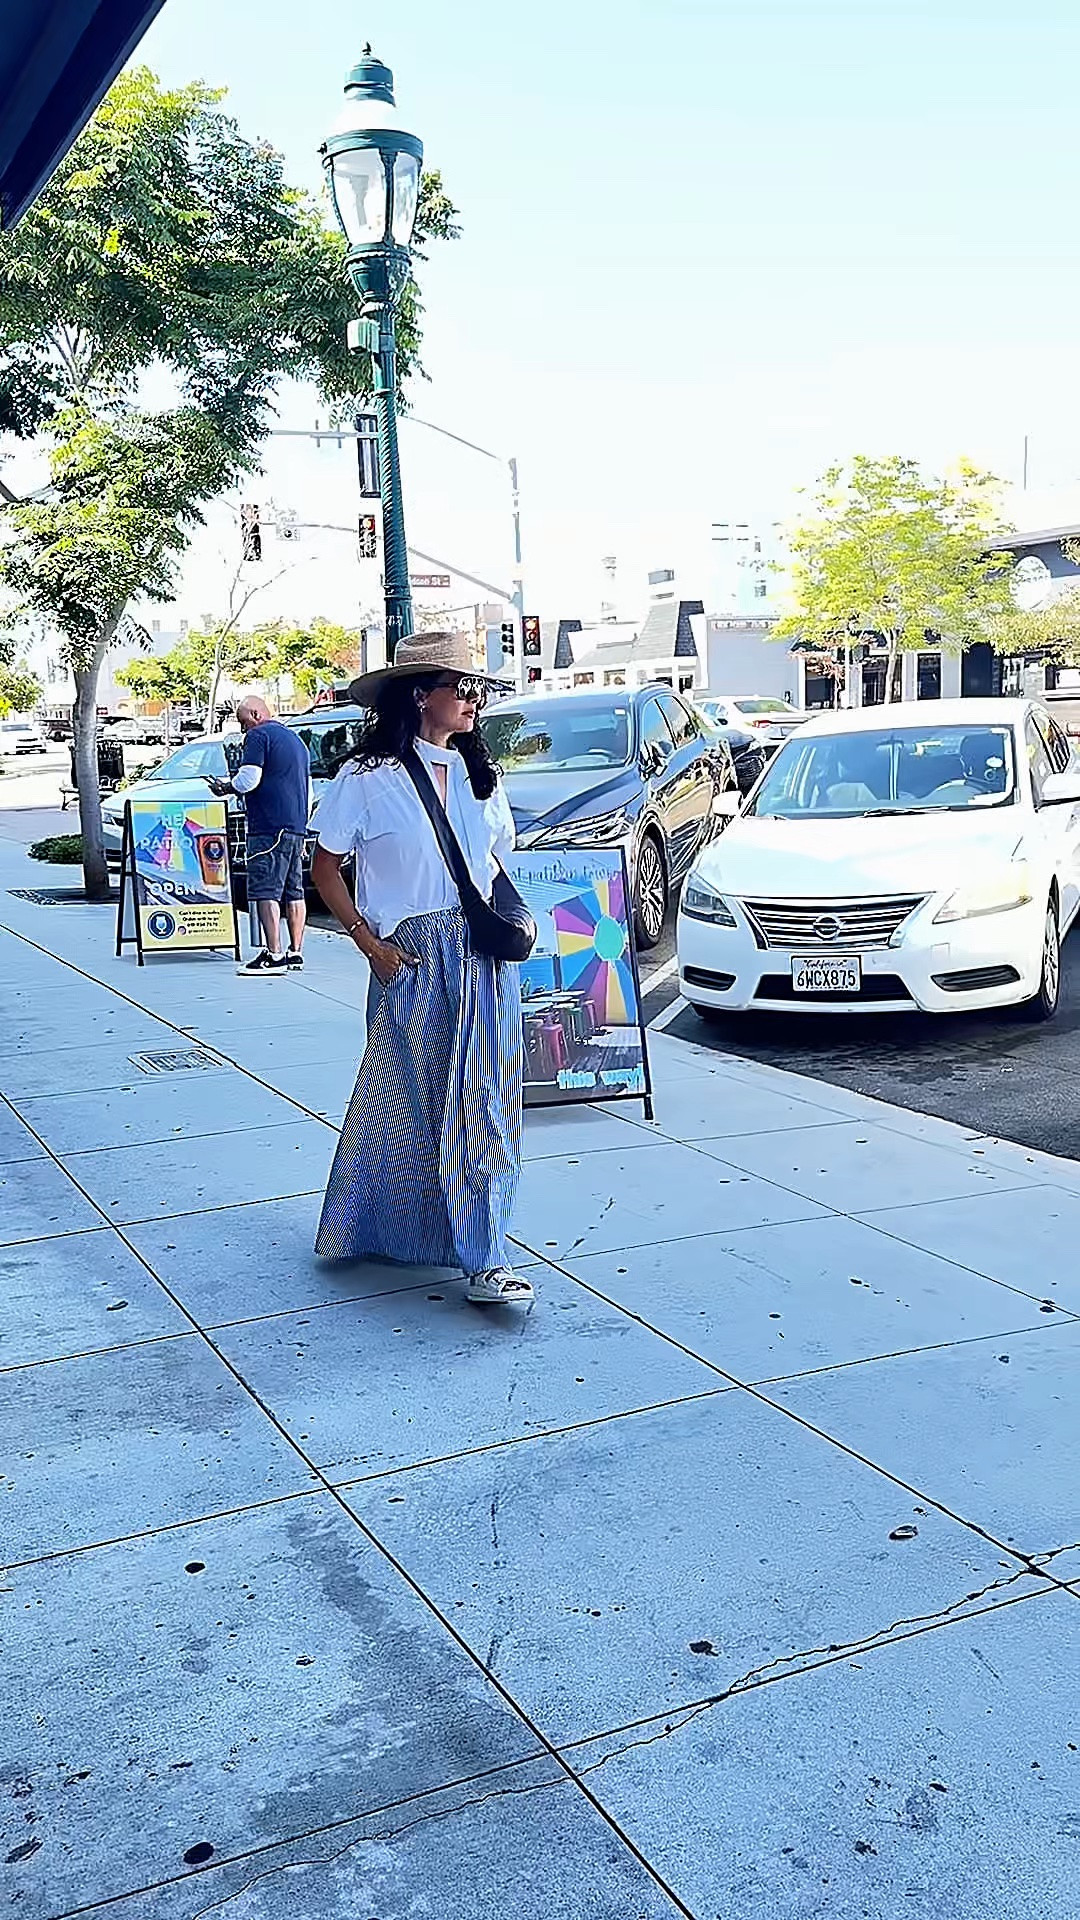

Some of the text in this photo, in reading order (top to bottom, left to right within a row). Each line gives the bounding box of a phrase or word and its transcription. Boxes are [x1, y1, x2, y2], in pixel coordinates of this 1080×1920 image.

[141, 835, 193, 850] PATIO
[149, 880, 197, 896] OPEN
[797, 969, 856, 988] 6WCX875
[556, 1068, 596, 1089] this
